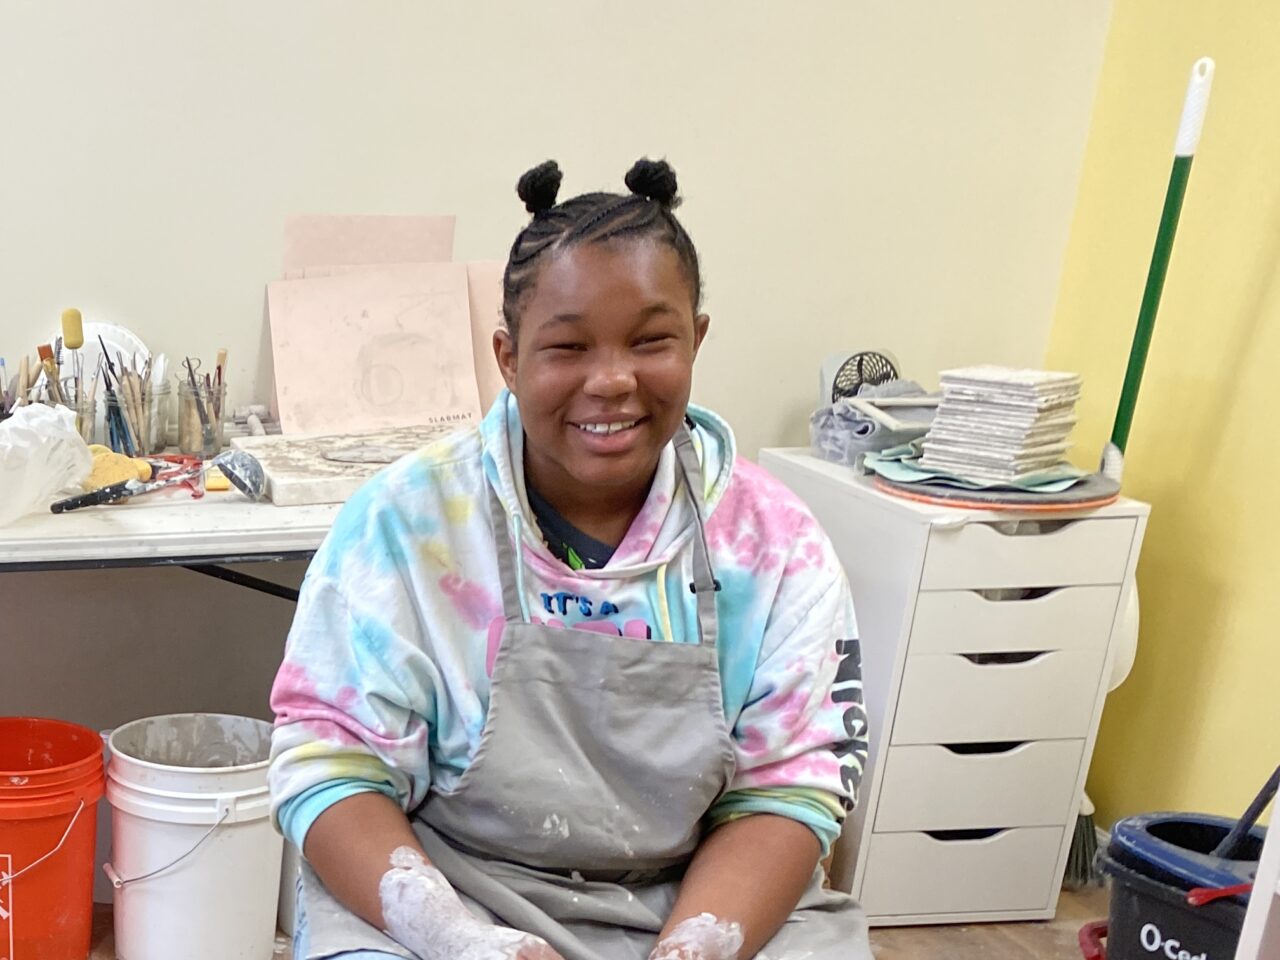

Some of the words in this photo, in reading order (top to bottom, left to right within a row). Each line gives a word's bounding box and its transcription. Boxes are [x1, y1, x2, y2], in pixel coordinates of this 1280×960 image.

[428, 412, 472, 424] SLABMAT
[540, 592, 593, 617] IT'S
[599, 601, 619, 616] A
[831, 638, 869, 812] NICKE
